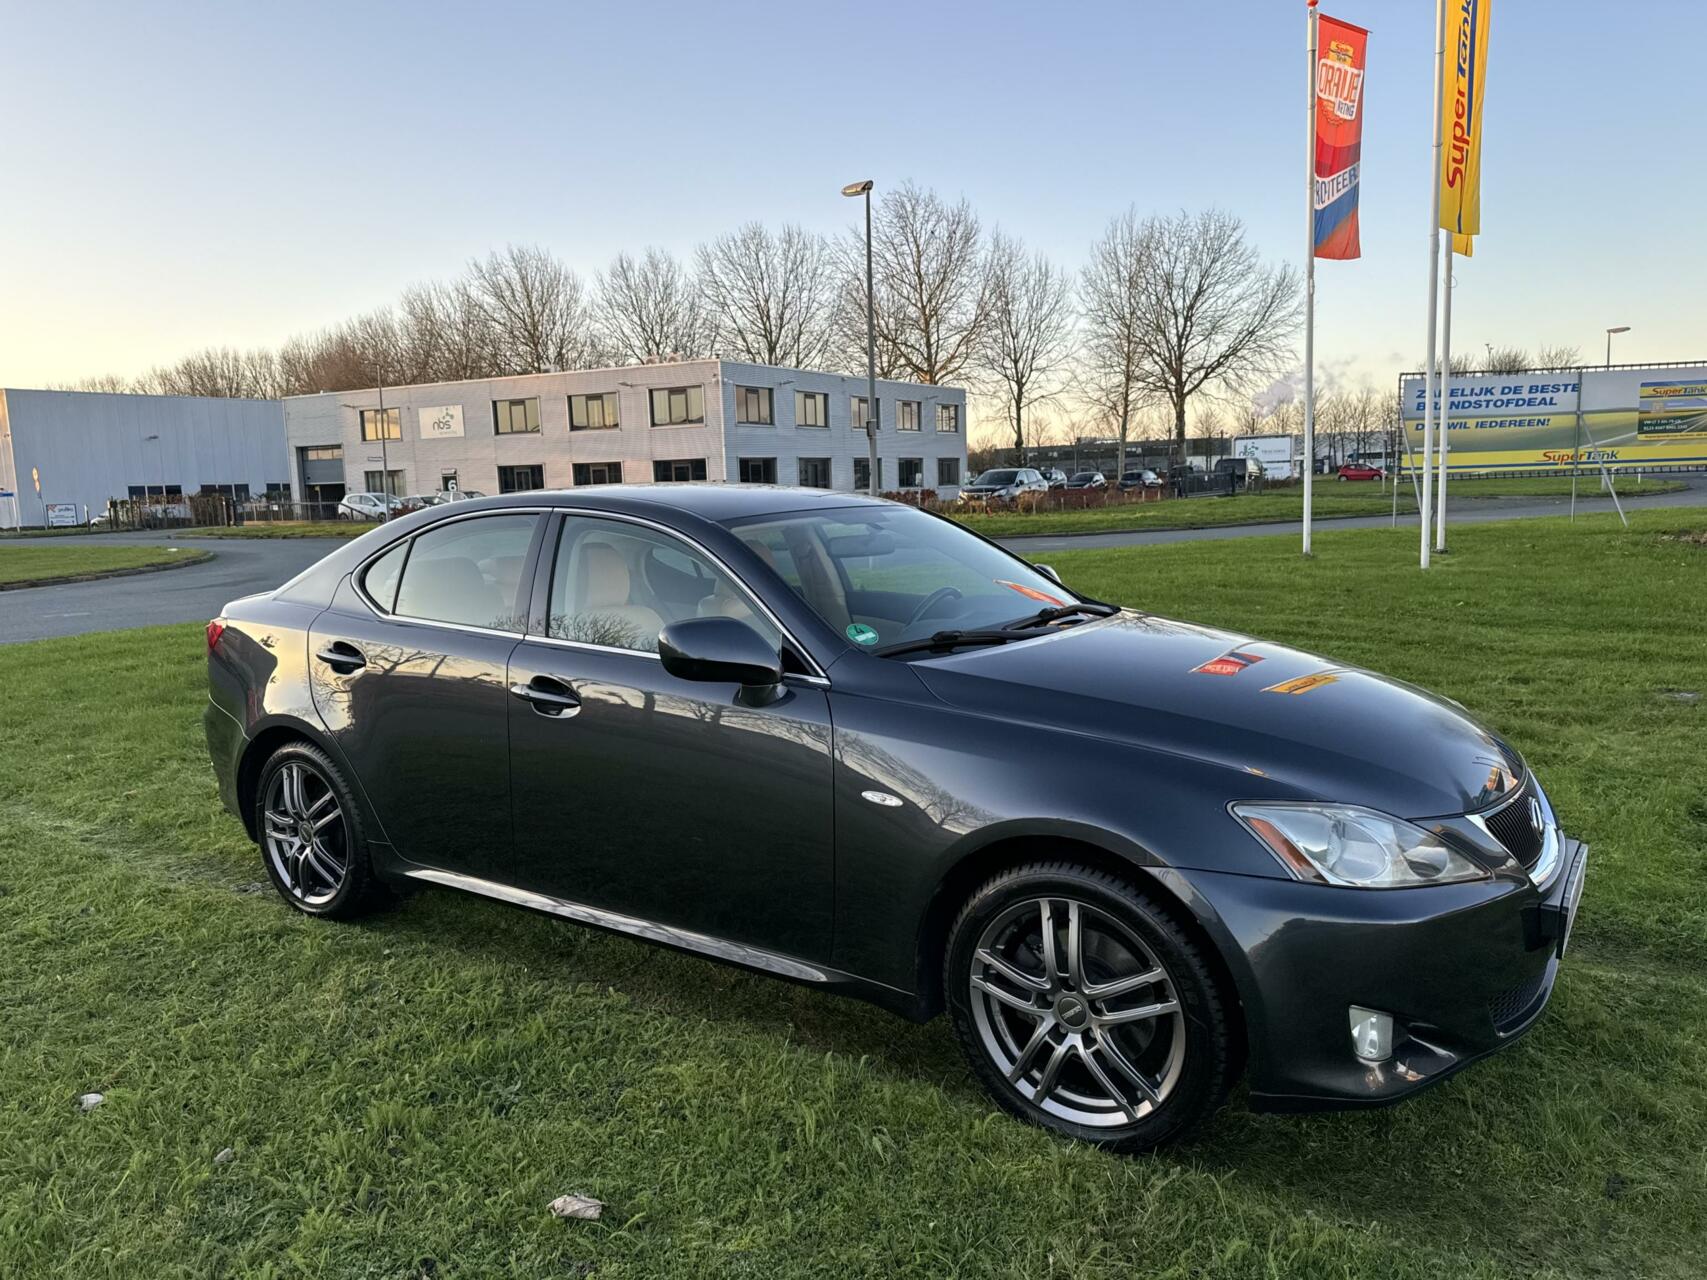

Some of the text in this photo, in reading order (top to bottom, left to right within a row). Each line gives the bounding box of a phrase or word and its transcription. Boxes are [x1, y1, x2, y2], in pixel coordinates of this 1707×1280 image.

[1500, 385, 1524, 396] DE
[1528, 383, 1580, 394] BESTE
[1415, 396, 1558, 411] BNDSTOFDEAL
[1414, 418, 1551, 431] DT WIL IEDEREEN!
[1542, 450, 1619, 465] SuperTank
[448, 480, 457, 492] 6
